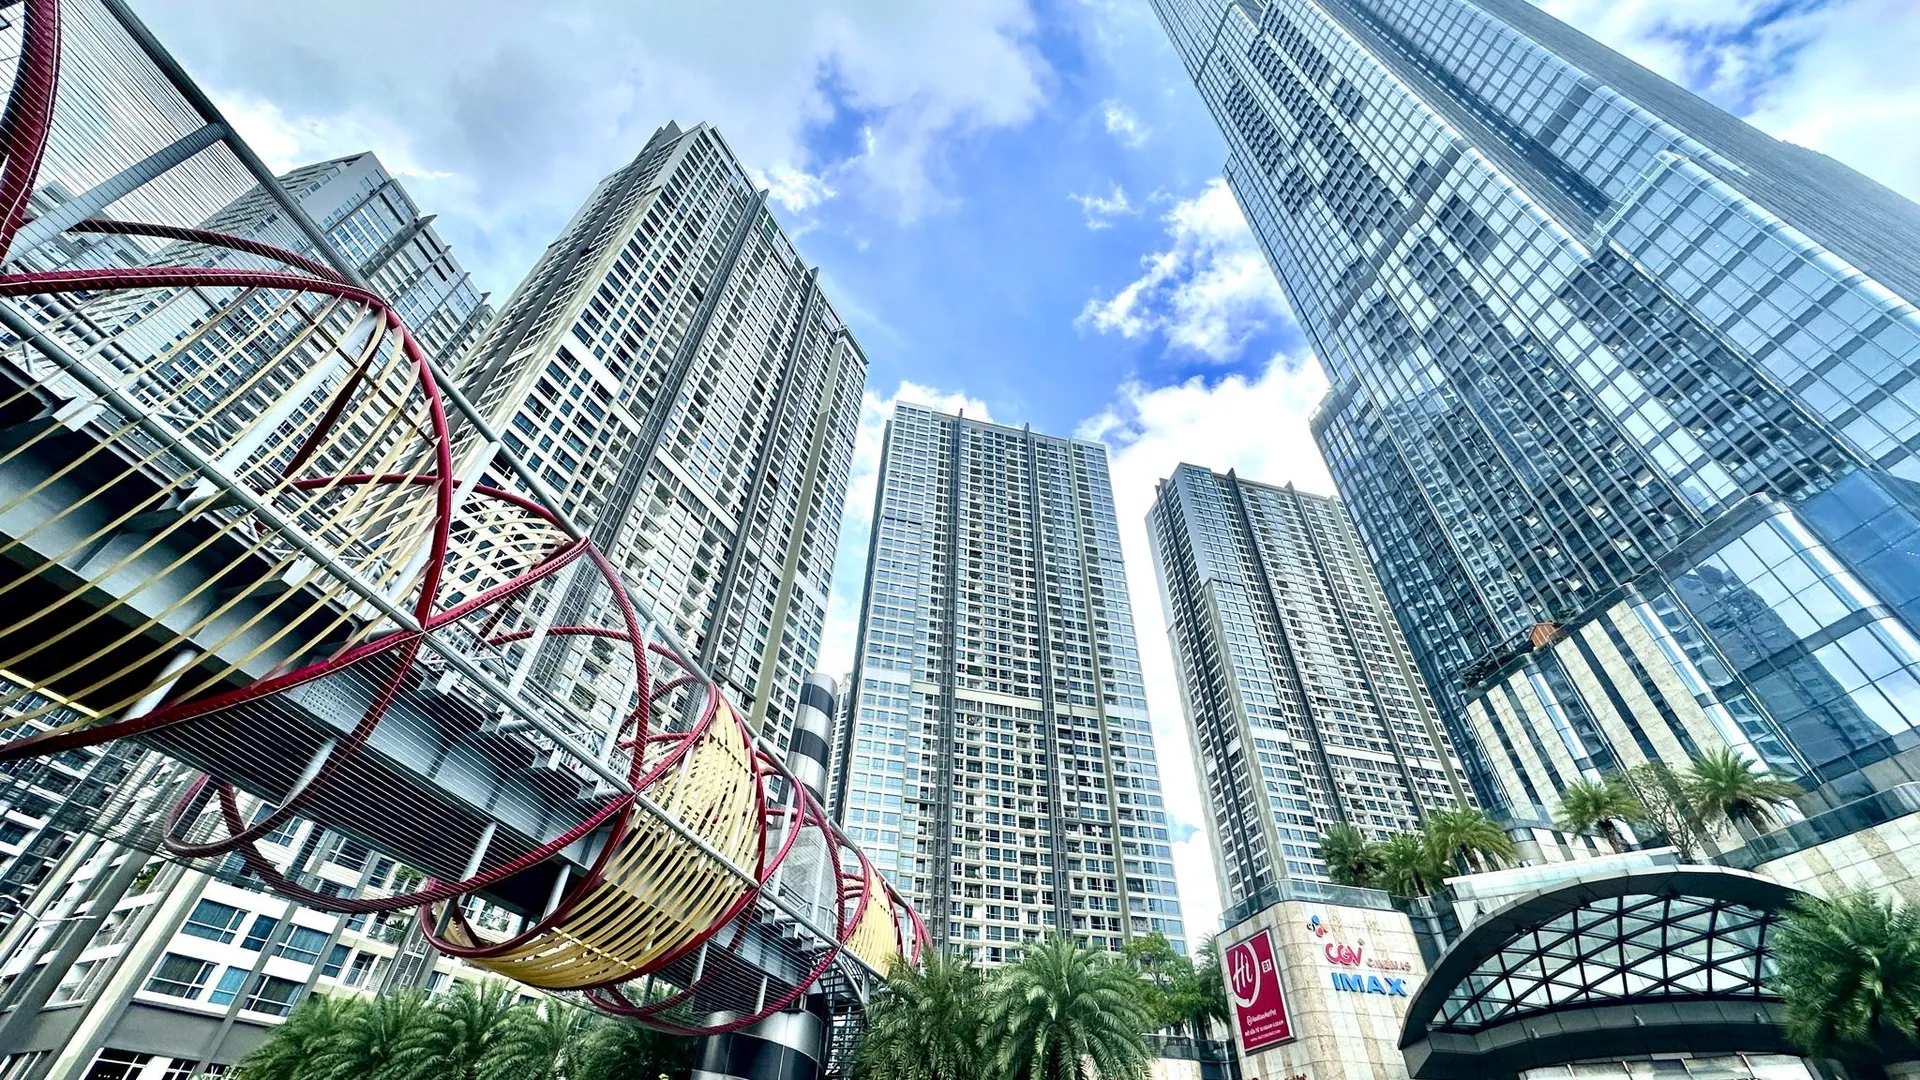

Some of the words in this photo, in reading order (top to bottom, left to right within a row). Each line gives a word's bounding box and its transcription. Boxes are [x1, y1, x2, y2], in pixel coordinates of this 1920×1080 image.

[1325, 943, 1362, 966] CGV
[1233, 950, 1253, 993] Hi
[1331, 972, 1407, 997] IMAX
